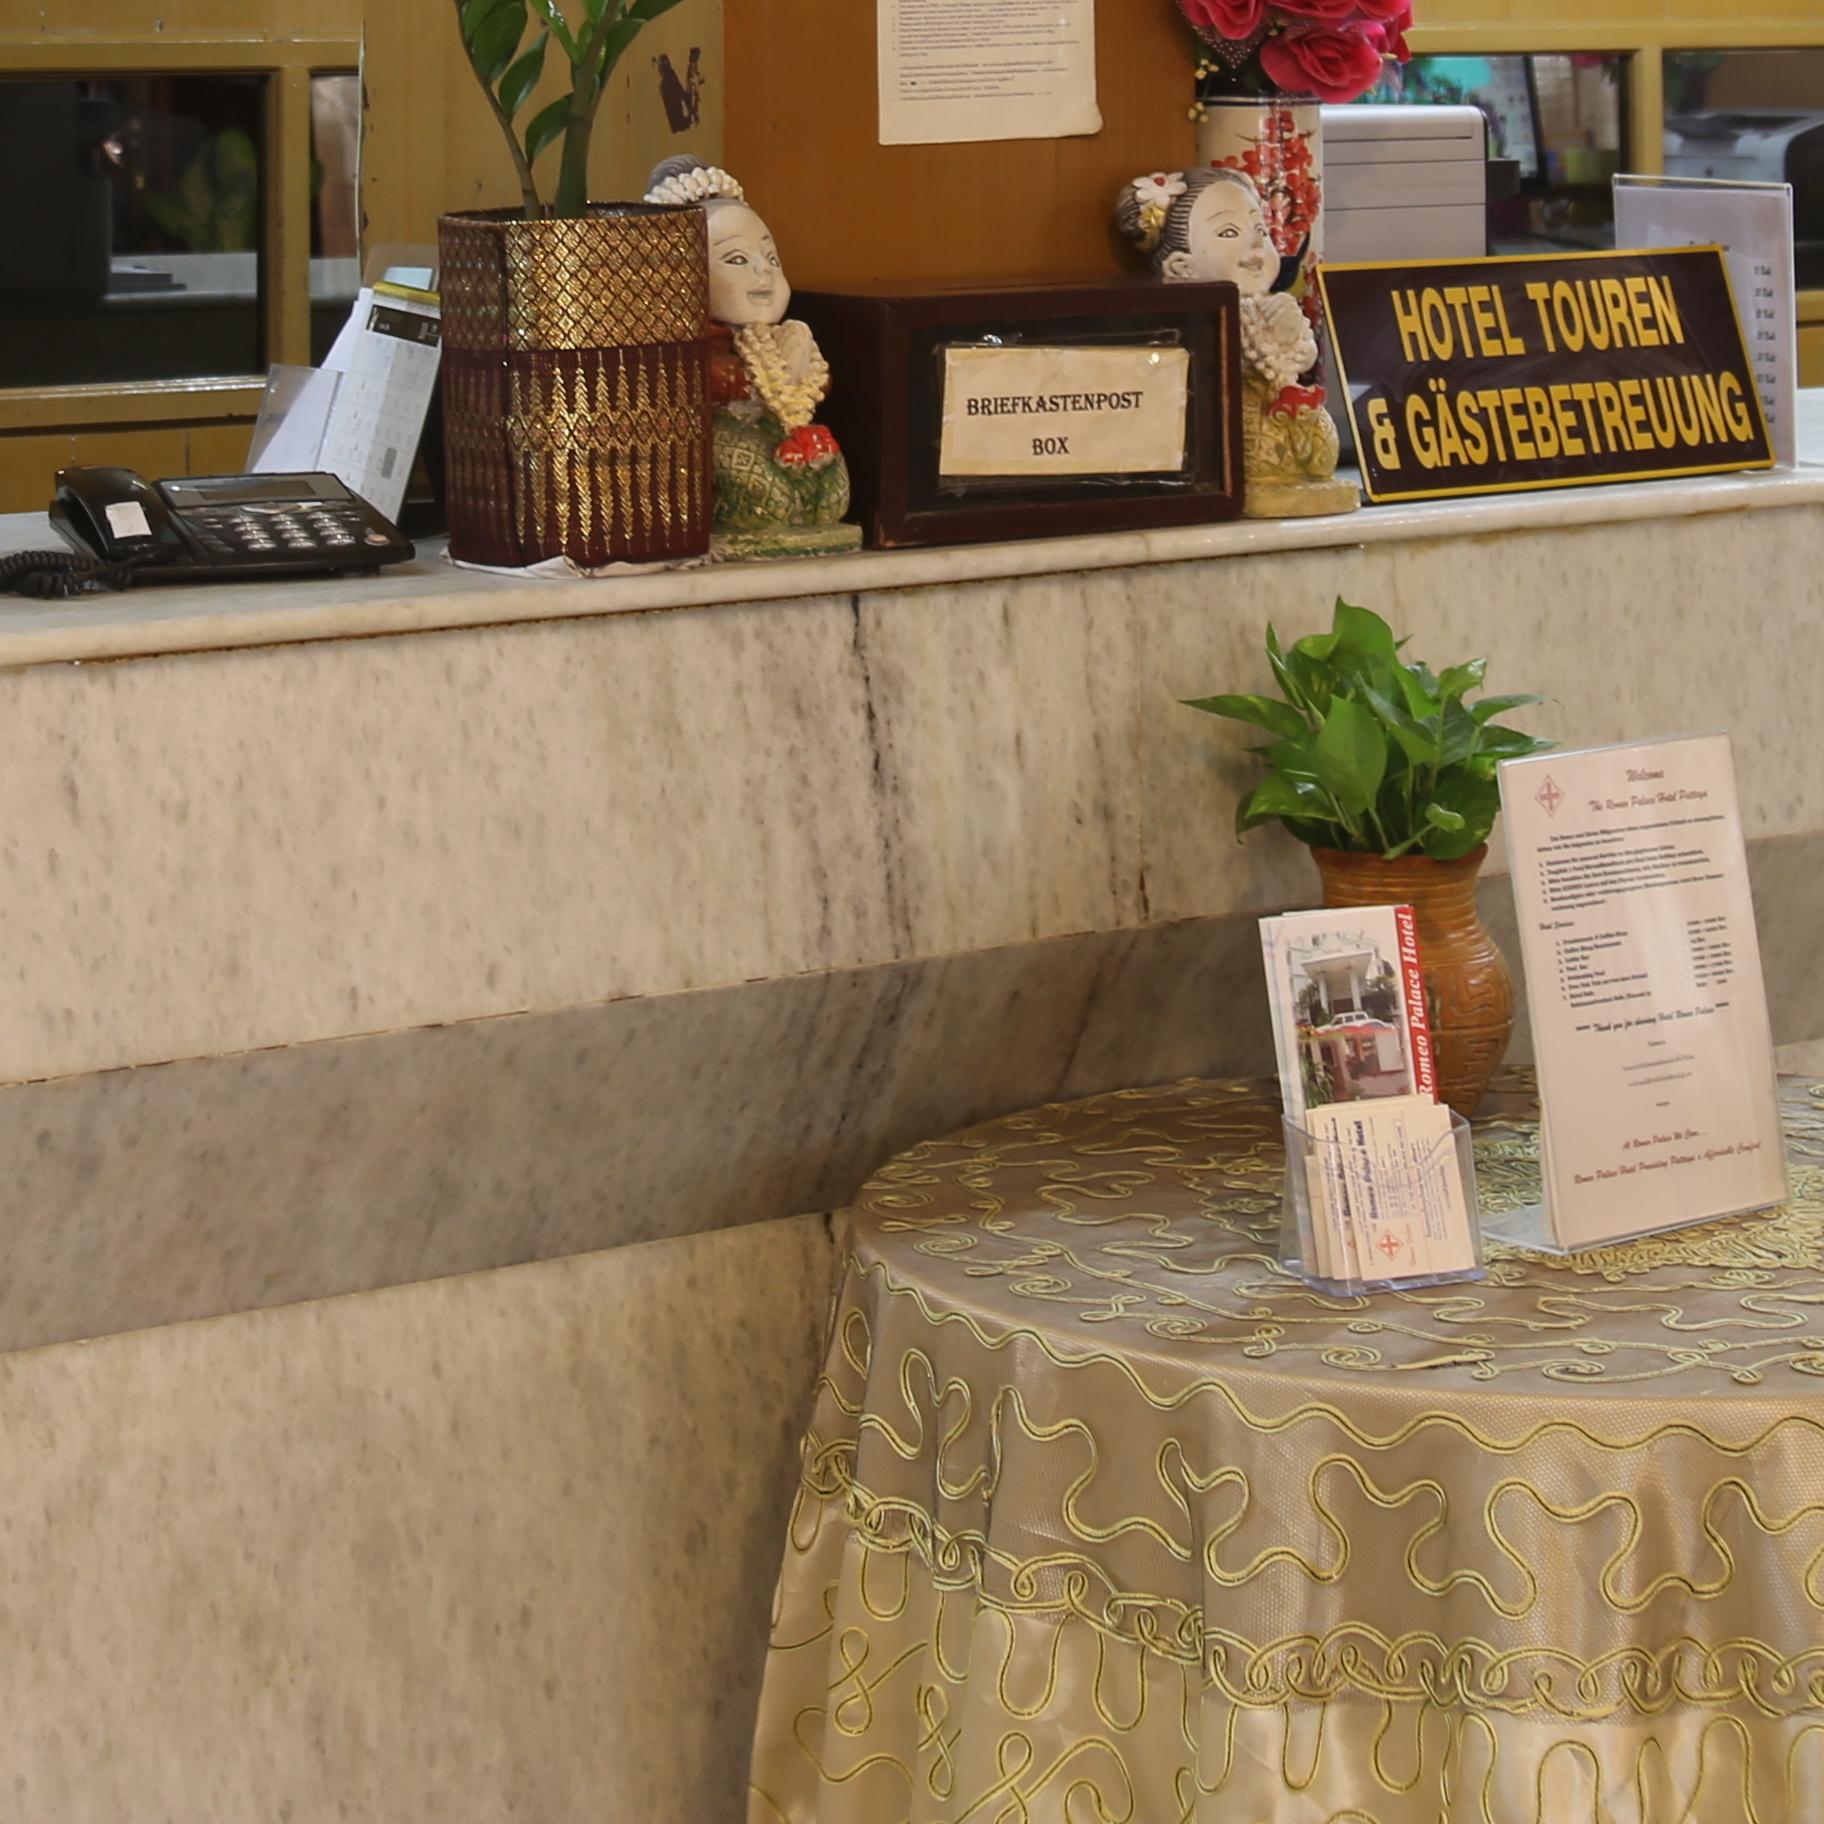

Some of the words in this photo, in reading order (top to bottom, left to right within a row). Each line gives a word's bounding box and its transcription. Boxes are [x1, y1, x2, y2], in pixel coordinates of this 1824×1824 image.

[1391, 285, 1525, 363] HOTEL
[1525, 276, 1685, 353] TOUREN
[967, 391, 1144, 416] BRIEFKASTENPOST
[1368, 398, 1401, 471] &
[1405, 370, 1754, 469] GÄSTEBETREUUNG
[1032, 437, 1070, 456] BOX
[1397, 913, 1419, 965] Hotel
[1406, 968, 1427, 1032] Palace
